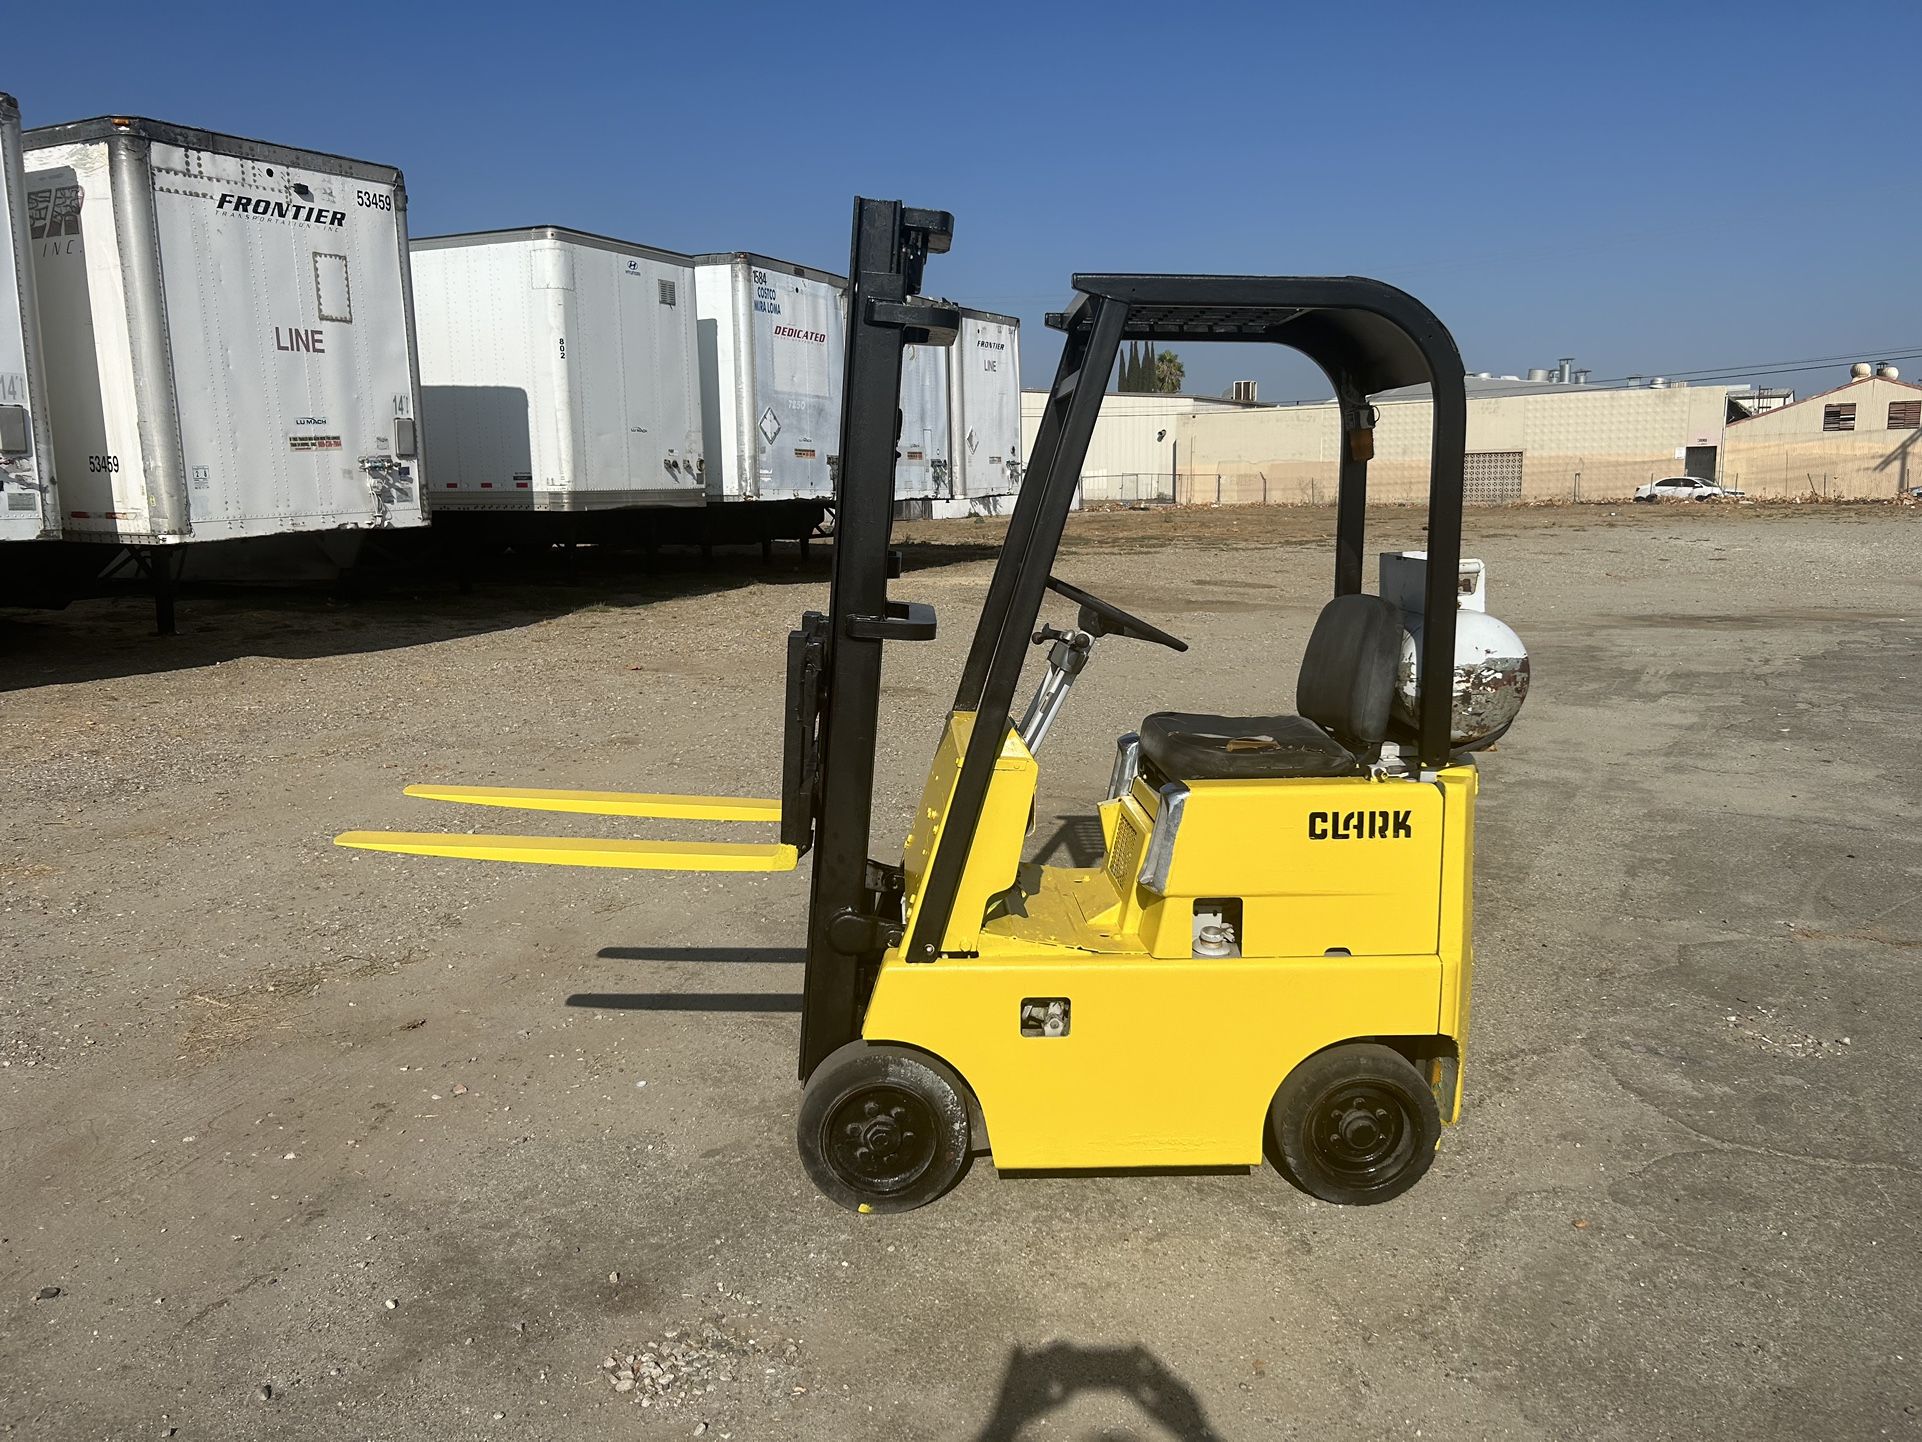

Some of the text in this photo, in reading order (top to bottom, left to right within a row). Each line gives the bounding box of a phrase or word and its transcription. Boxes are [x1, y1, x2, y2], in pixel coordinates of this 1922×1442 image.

[216, 193, 347, 227] FRONTIER
[356, 190, 392, 212] 53459
[757, 286, 777, 301] COSTCO
[275, 326, 325, 353] LINE
[774, 325, 826, 343] DEDICATED
[976, 340, 1005, 350] FRONTIER
[88, 455, 120, 473] 53459
[1308, 810, 1412, 840] CLARK
